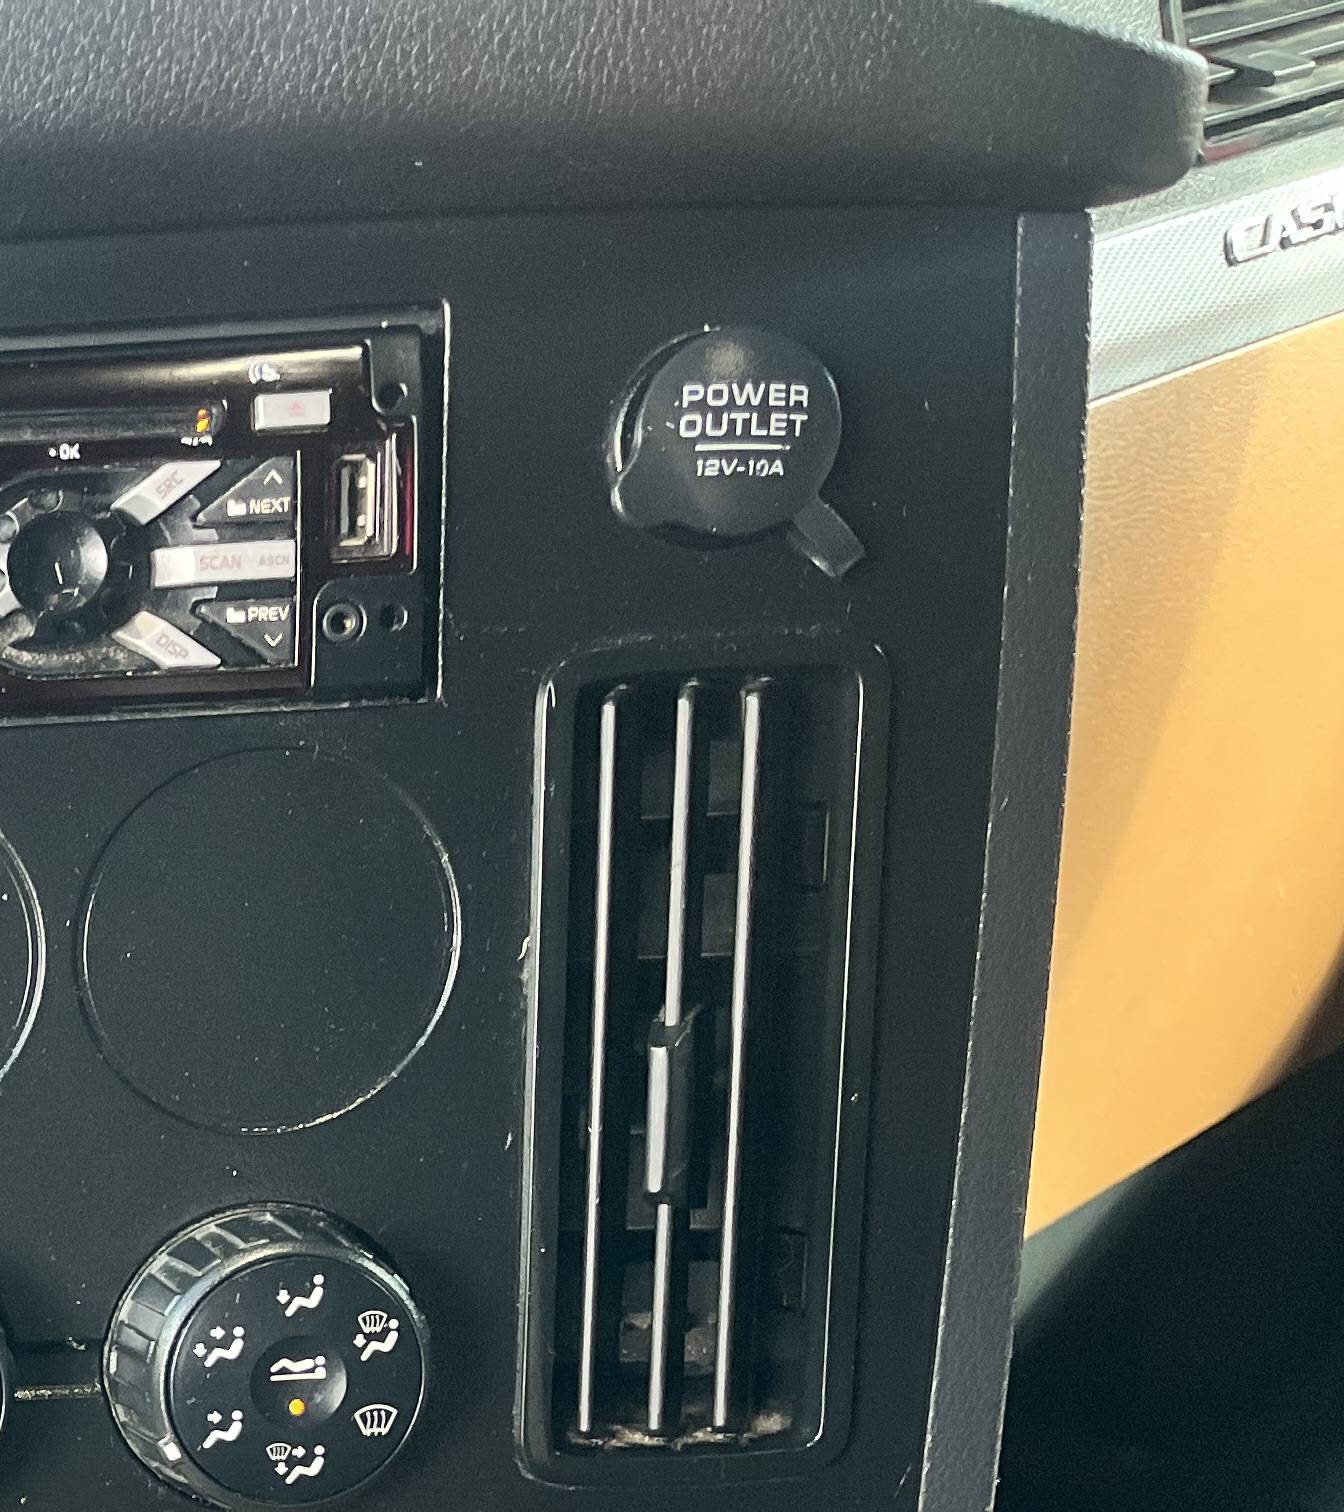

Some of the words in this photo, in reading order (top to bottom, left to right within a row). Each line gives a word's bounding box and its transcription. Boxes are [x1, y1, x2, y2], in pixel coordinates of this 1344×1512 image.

[681, 383, 809, 409] POWER
[678, 412, 809, 438] OUTLET
[696, 458, 785, 477] 12V-10A
[155, 470, 184, 499] SRC
[249, 496, 291, 515] NEXT
[200, 554, 242, 571] SCAN
[258, 554, 290, 567] ASCN
[248, 604, 290, 622] PREV
[155, 633, 189, 660] DISP
